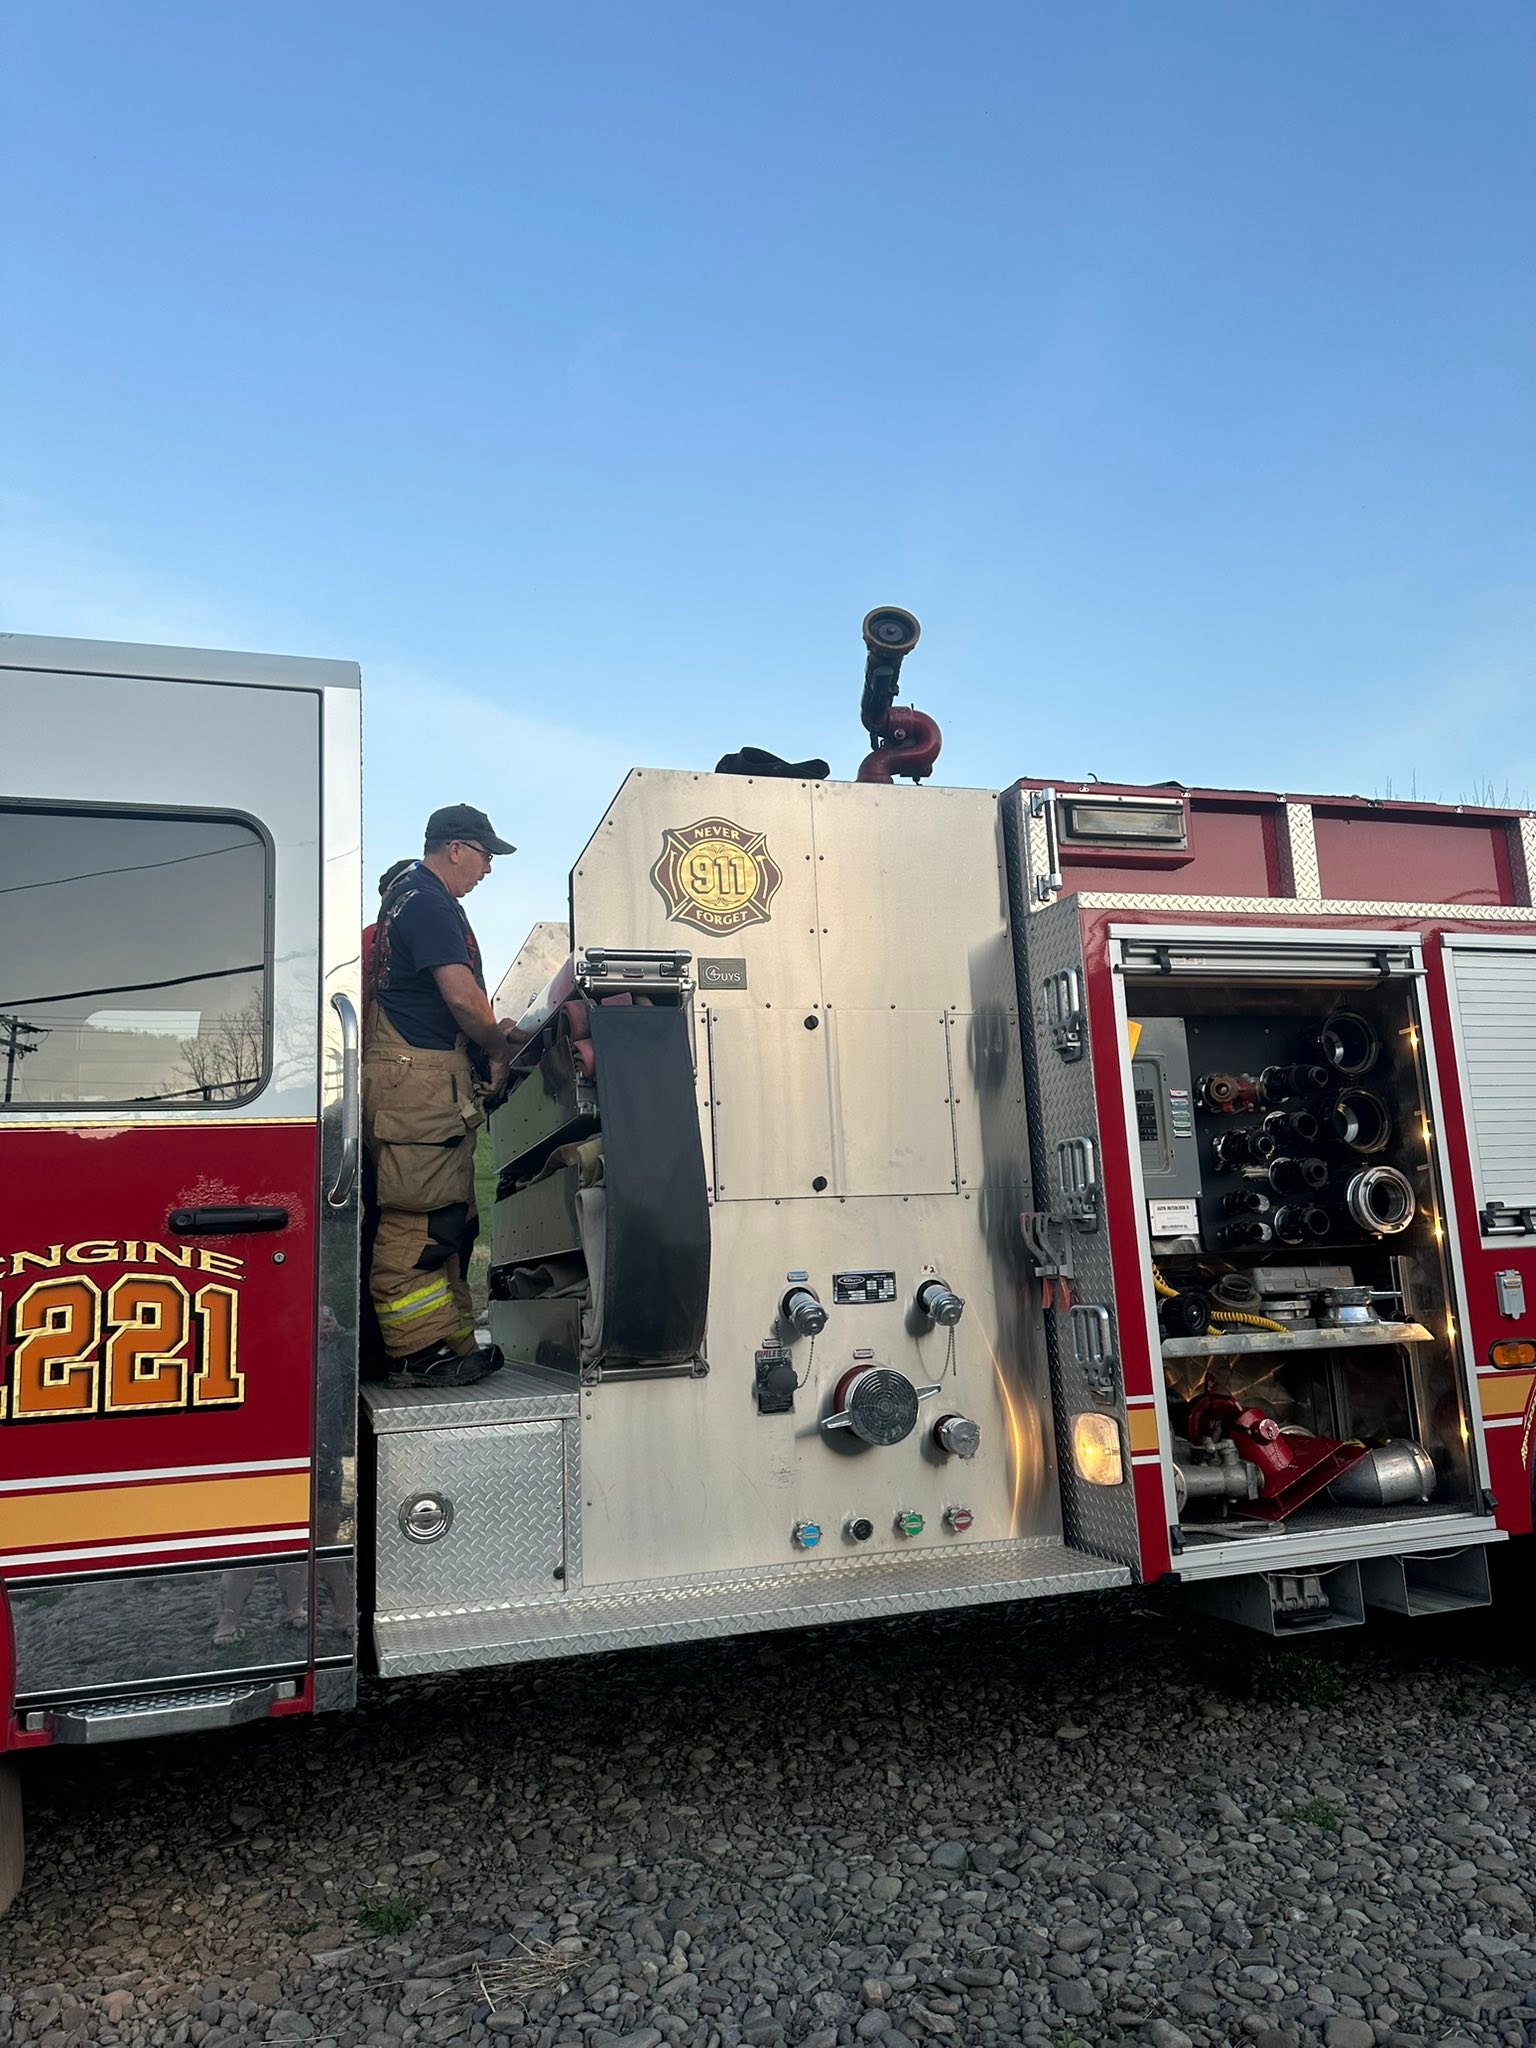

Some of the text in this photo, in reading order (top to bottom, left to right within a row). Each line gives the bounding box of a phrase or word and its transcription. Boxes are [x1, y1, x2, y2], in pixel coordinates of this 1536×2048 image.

[695, 827, 740, 840] NEVER
[691, 855, 746, 894] 911
[695, 910, 748, 925] FORGET
[0, 1240, 246, 1281] NGINE
[0, 1273, 245, 1420] 221
